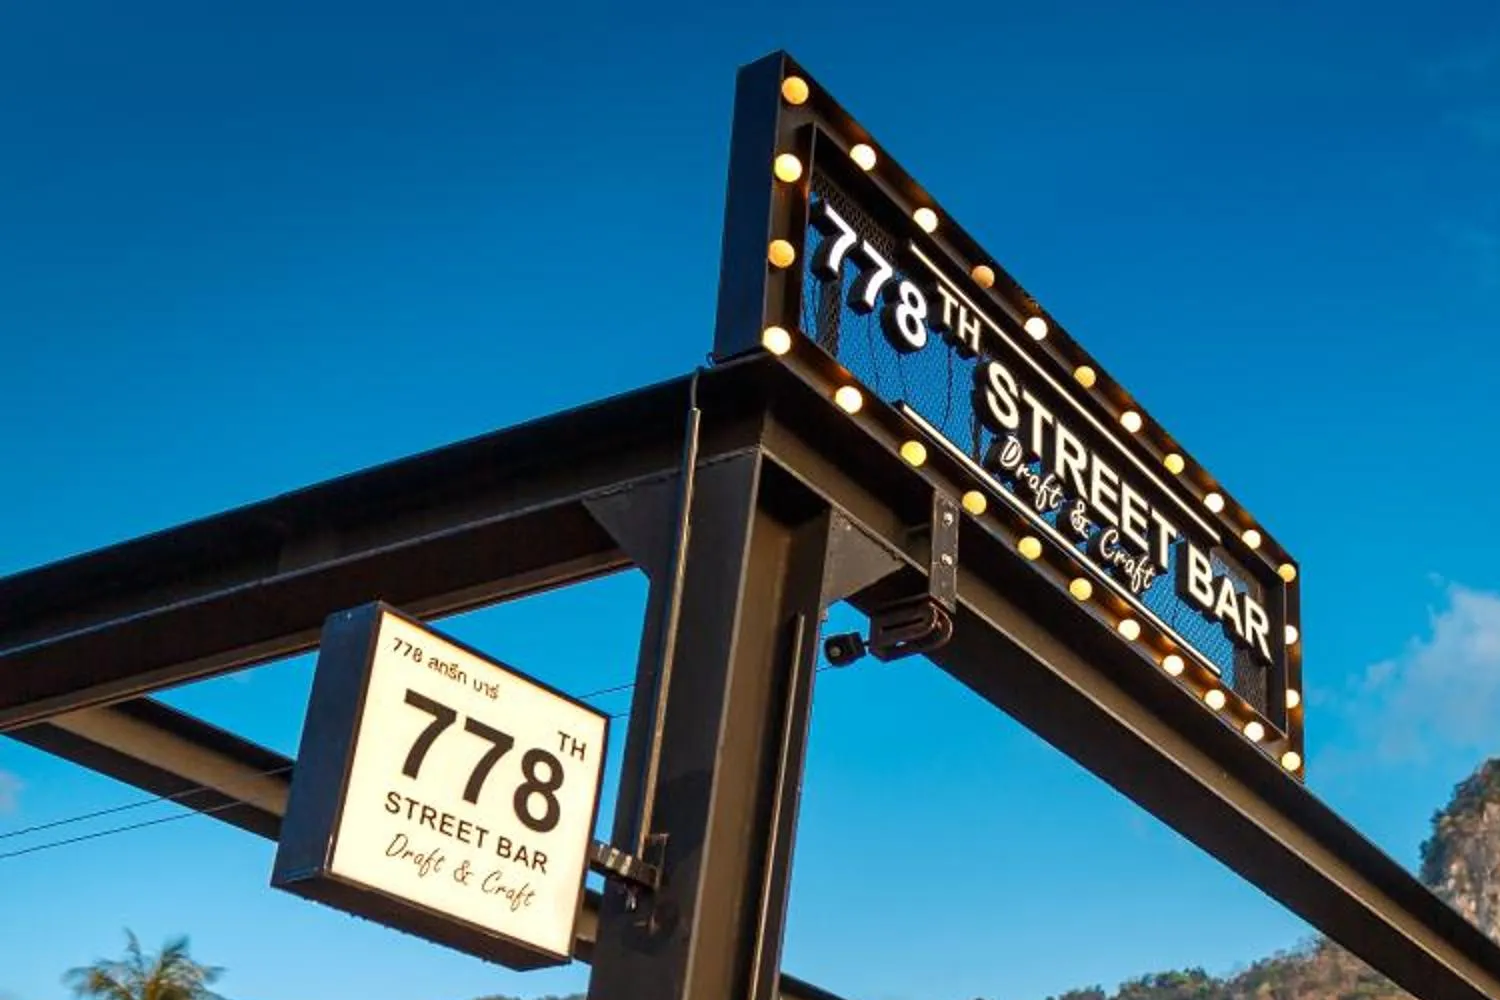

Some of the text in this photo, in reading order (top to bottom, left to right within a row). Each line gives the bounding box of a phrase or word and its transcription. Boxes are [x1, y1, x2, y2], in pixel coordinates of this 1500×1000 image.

[986, 361, 1177, 569] STREET
[1187, 543, 1271, 664] BAR
[1001, 435, 1156, 592] Draft & Craft
[393, 637, 423, 663] 778
[385, 790, 547, 874] STREET BAR
[385, 833, 536, 912] Draft & Craft
